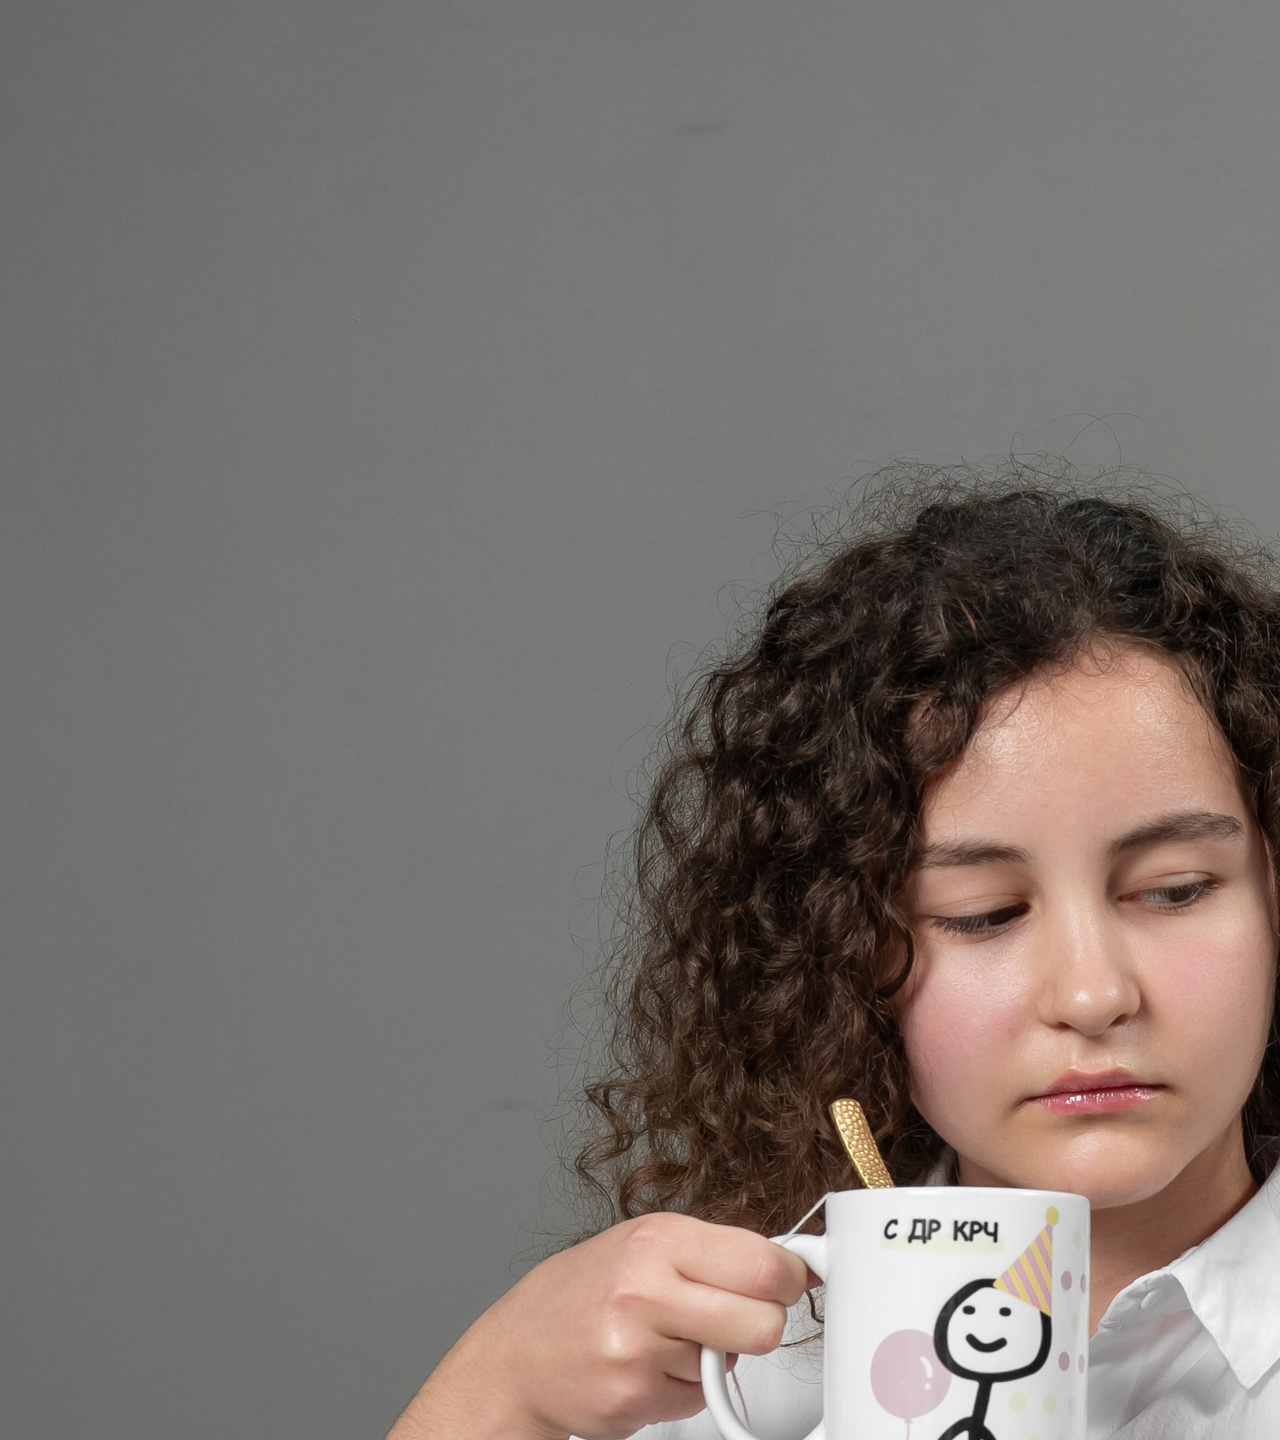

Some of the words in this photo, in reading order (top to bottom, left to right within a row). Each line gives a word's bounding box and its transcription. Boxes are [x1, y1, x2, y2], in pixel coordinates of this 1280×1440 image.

[884, 1219, 898, 1240] С
[907, 1218, 942, 1244] ДР
[953, 1220, 998, 1243] КРЧ
